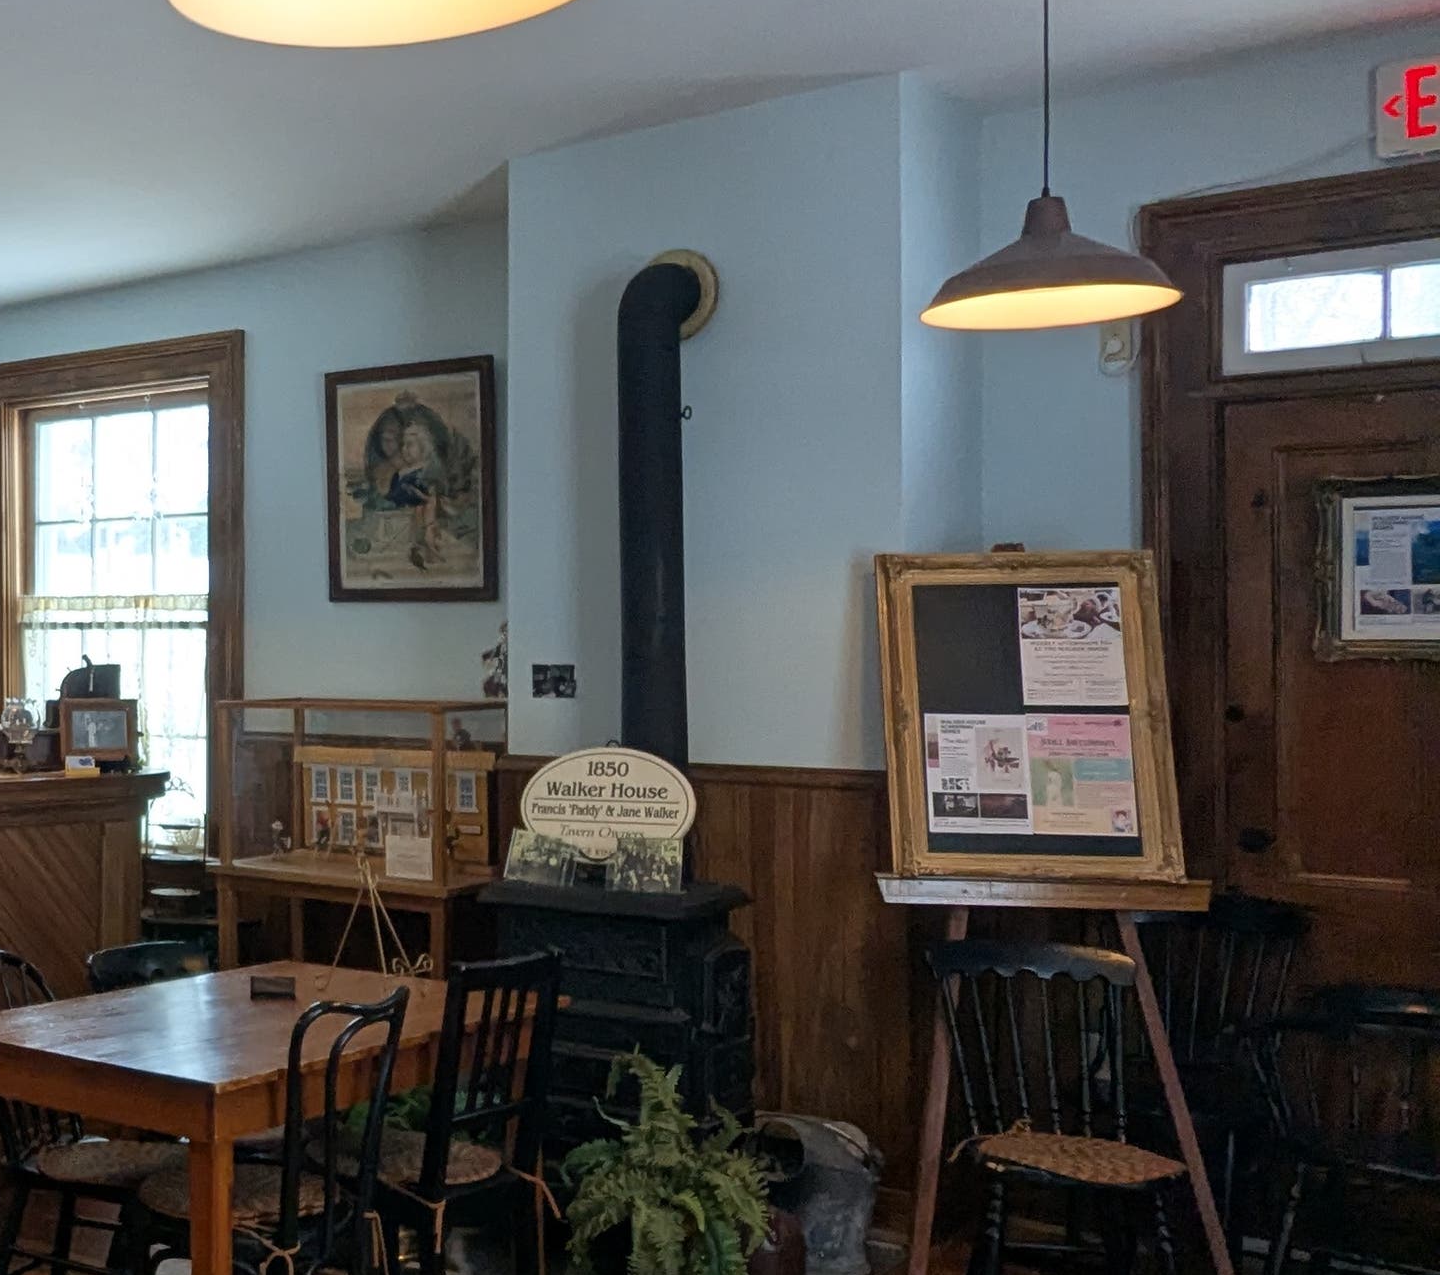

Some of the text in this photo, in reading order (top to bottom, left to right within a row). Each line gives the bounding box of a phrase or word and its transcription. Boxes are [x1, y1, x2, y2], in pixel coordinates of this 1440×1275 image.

[587, 761, 630, 778] 1850
[546, 781, 669, 800] Walker House
[531, 802, 567, 816] Francis
[606, 805, 615, 817] &
[617, 805, 641, 819] Jane
[644, 806, 680, 820] Walker
[559, 824, 595, 838] Tavern
